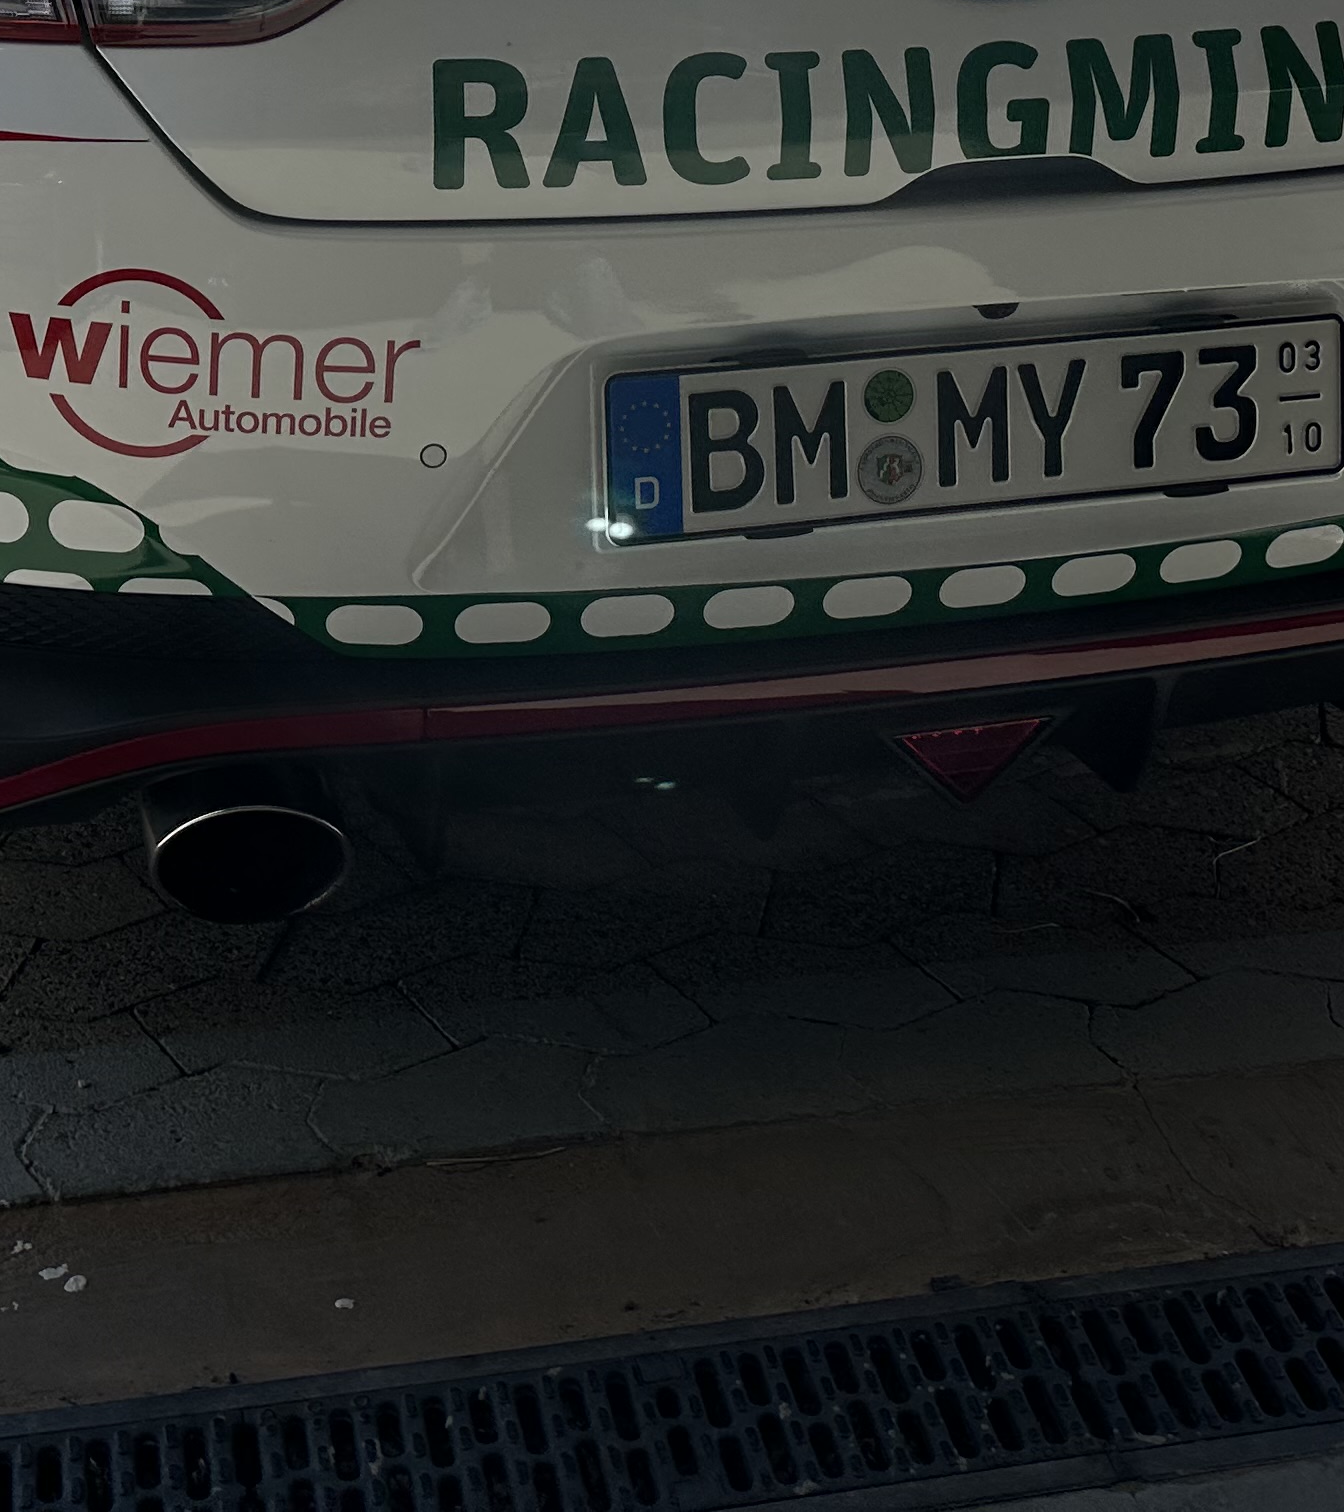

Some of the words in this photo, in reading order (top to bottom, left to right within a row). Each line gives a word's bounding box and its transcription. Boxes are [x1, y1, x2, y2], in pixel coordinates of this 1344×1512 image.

[9, 300, 421, 403] wiemer
[1277, 339, 1322, 374] 03
[168, 399, 392, 438] Automobile
[688, 380, 849, 514] BM
[937, 359, 1085, 487] MY
[1120, 344, 1258, 469] 73
[1282, 422, 1323, 456] 10
[634, 476, 660, 510] D
